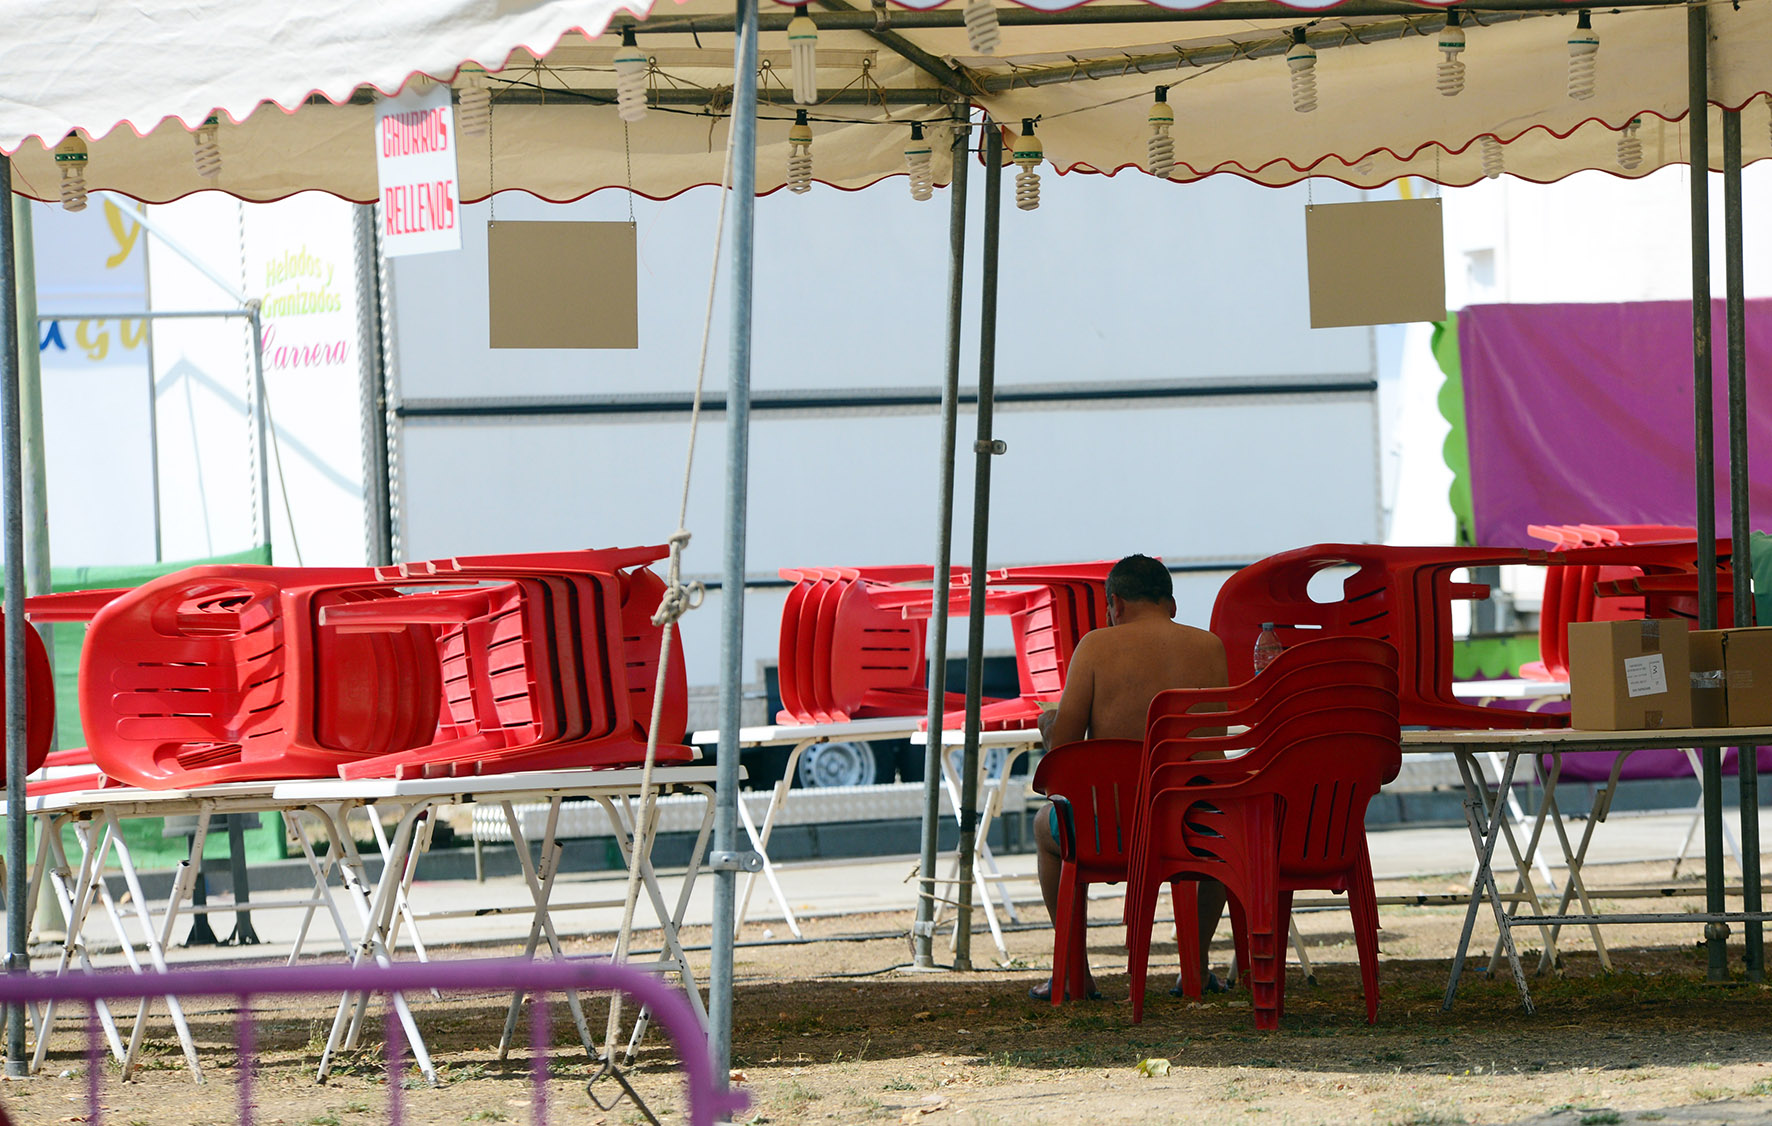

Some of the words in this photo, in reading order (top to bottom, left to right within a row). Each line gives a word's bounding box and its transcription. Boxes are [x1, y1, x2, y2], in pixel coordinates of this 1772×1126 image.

[382, 107, 448, 158] CHURROS
[385, 180, 454, 236] RELLENOS
[265, 243, 323, 289] Helados
[326, 261, 335, 288] y
[261, 282, 342, 319] Granizados
